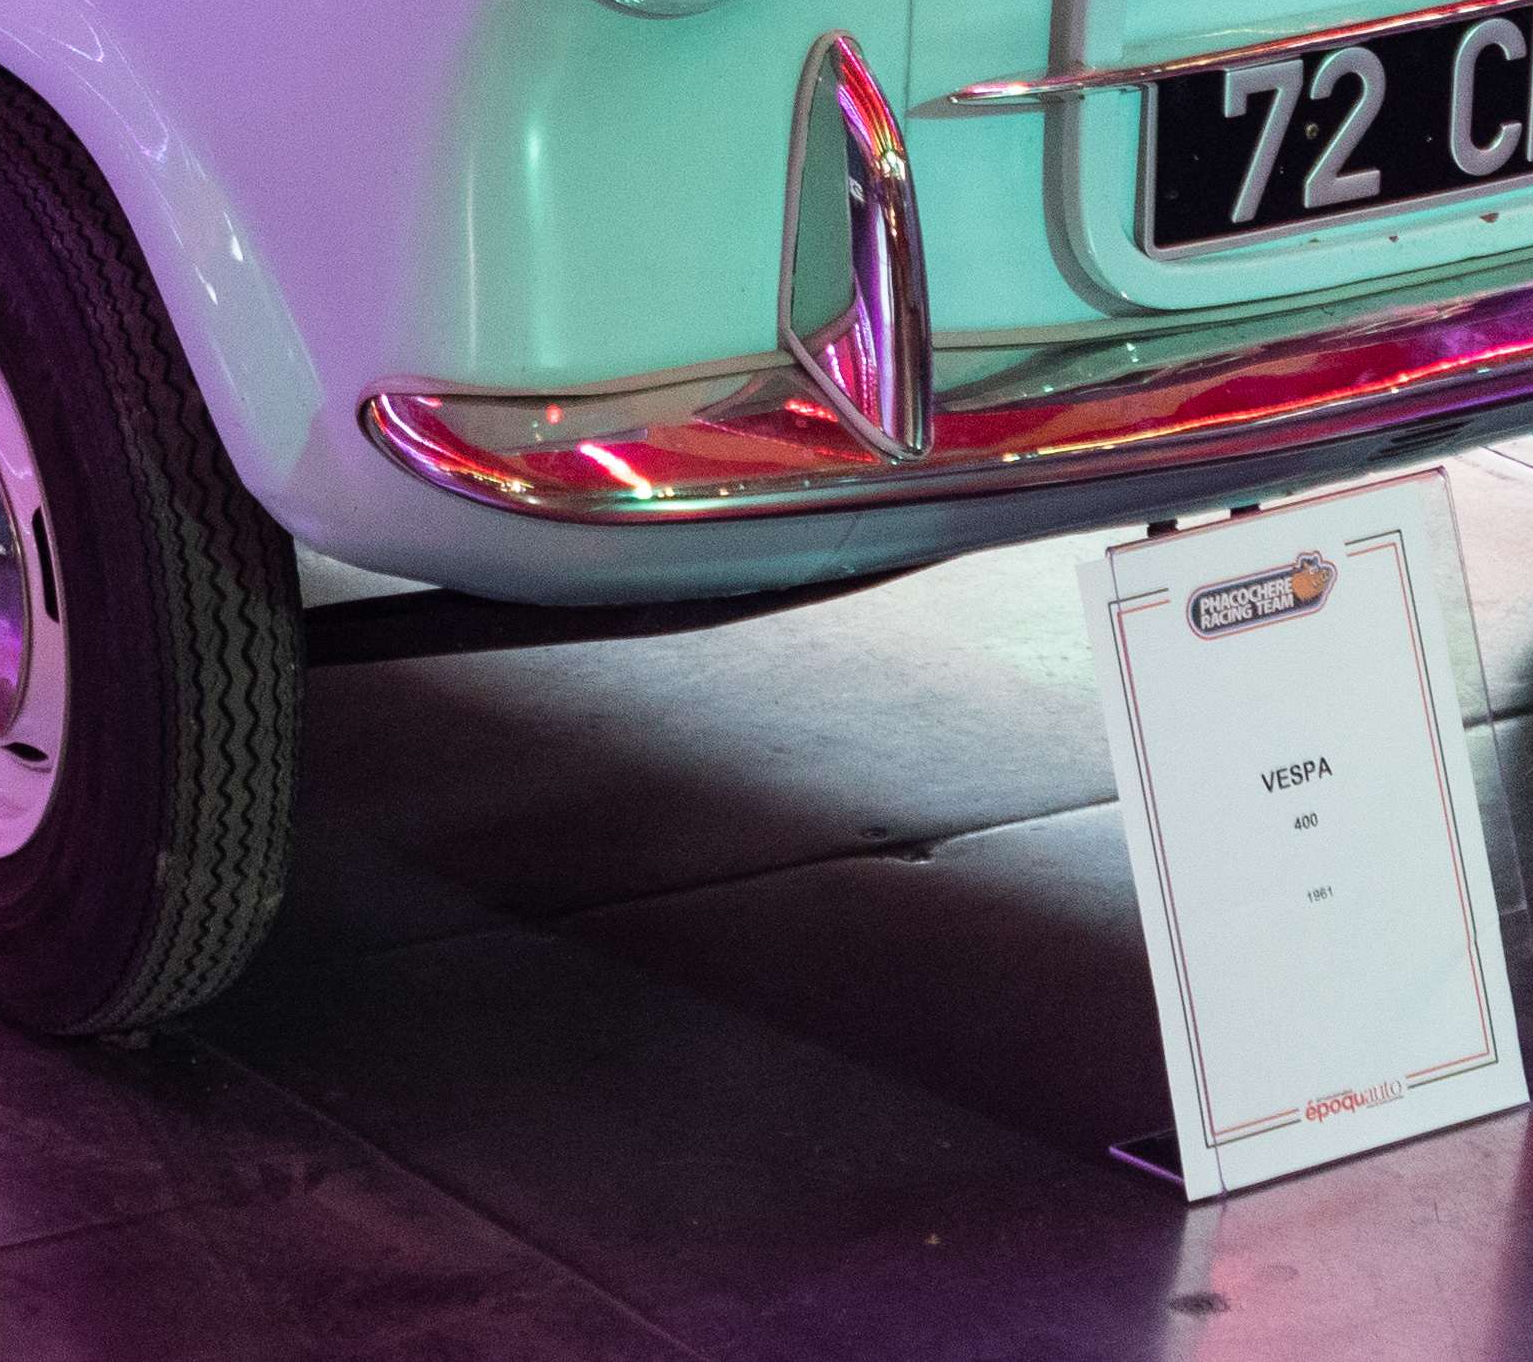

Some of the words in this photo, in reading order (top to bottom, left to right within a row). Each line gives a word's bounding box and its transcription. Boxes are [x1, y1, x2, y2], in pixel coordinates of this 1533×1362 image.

[1223, 45, 1387, 224] 72
[1199, 577, 1293, 616] PHACOCHERE
[1201, 602, 1253, 630] RACING
[1256, 594, 1295, 616] TEAM
[1261, 756, 1333, 793] VESPA
[1294, 812, 1319, 831] 400
[1307, 885, 1334, 904] 1961
